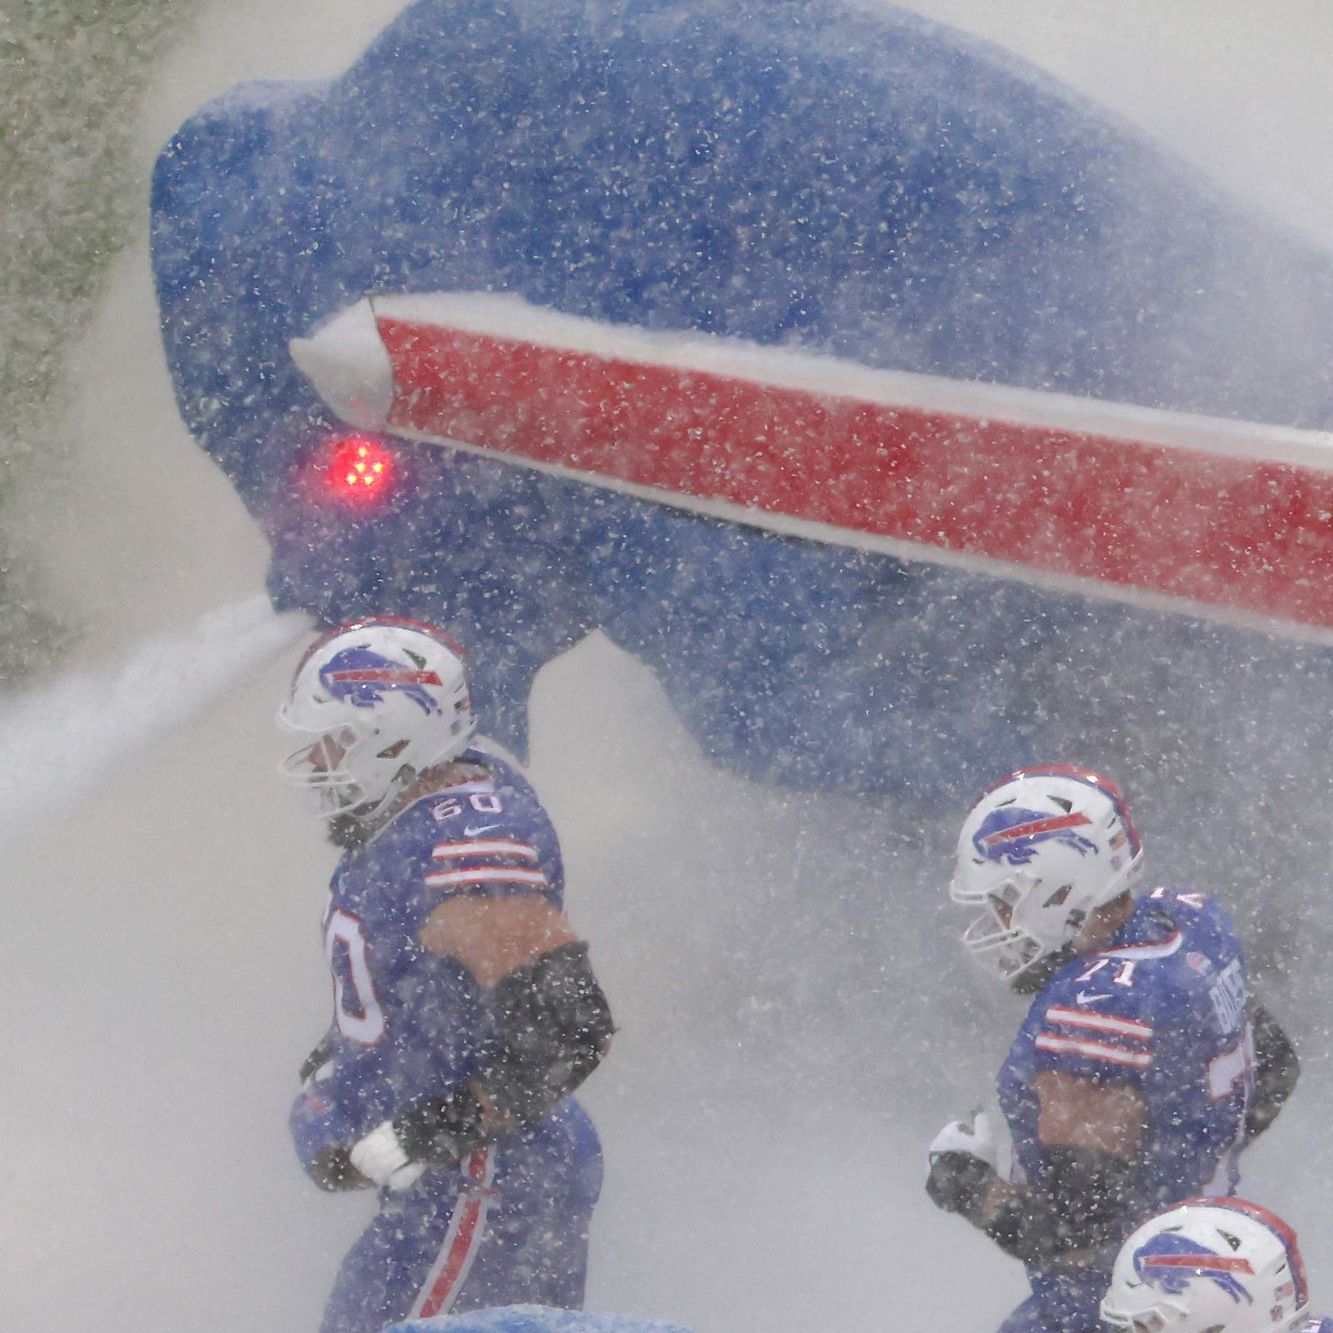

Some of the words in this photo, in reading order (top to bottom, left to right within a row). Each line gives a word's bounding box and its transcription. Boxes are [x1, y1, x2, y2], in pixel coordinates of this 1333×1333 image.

[433, 793, 503, 821] 60
[323, 893, 386, 1047] 0
[1074, 957, 1137, 987] 71
